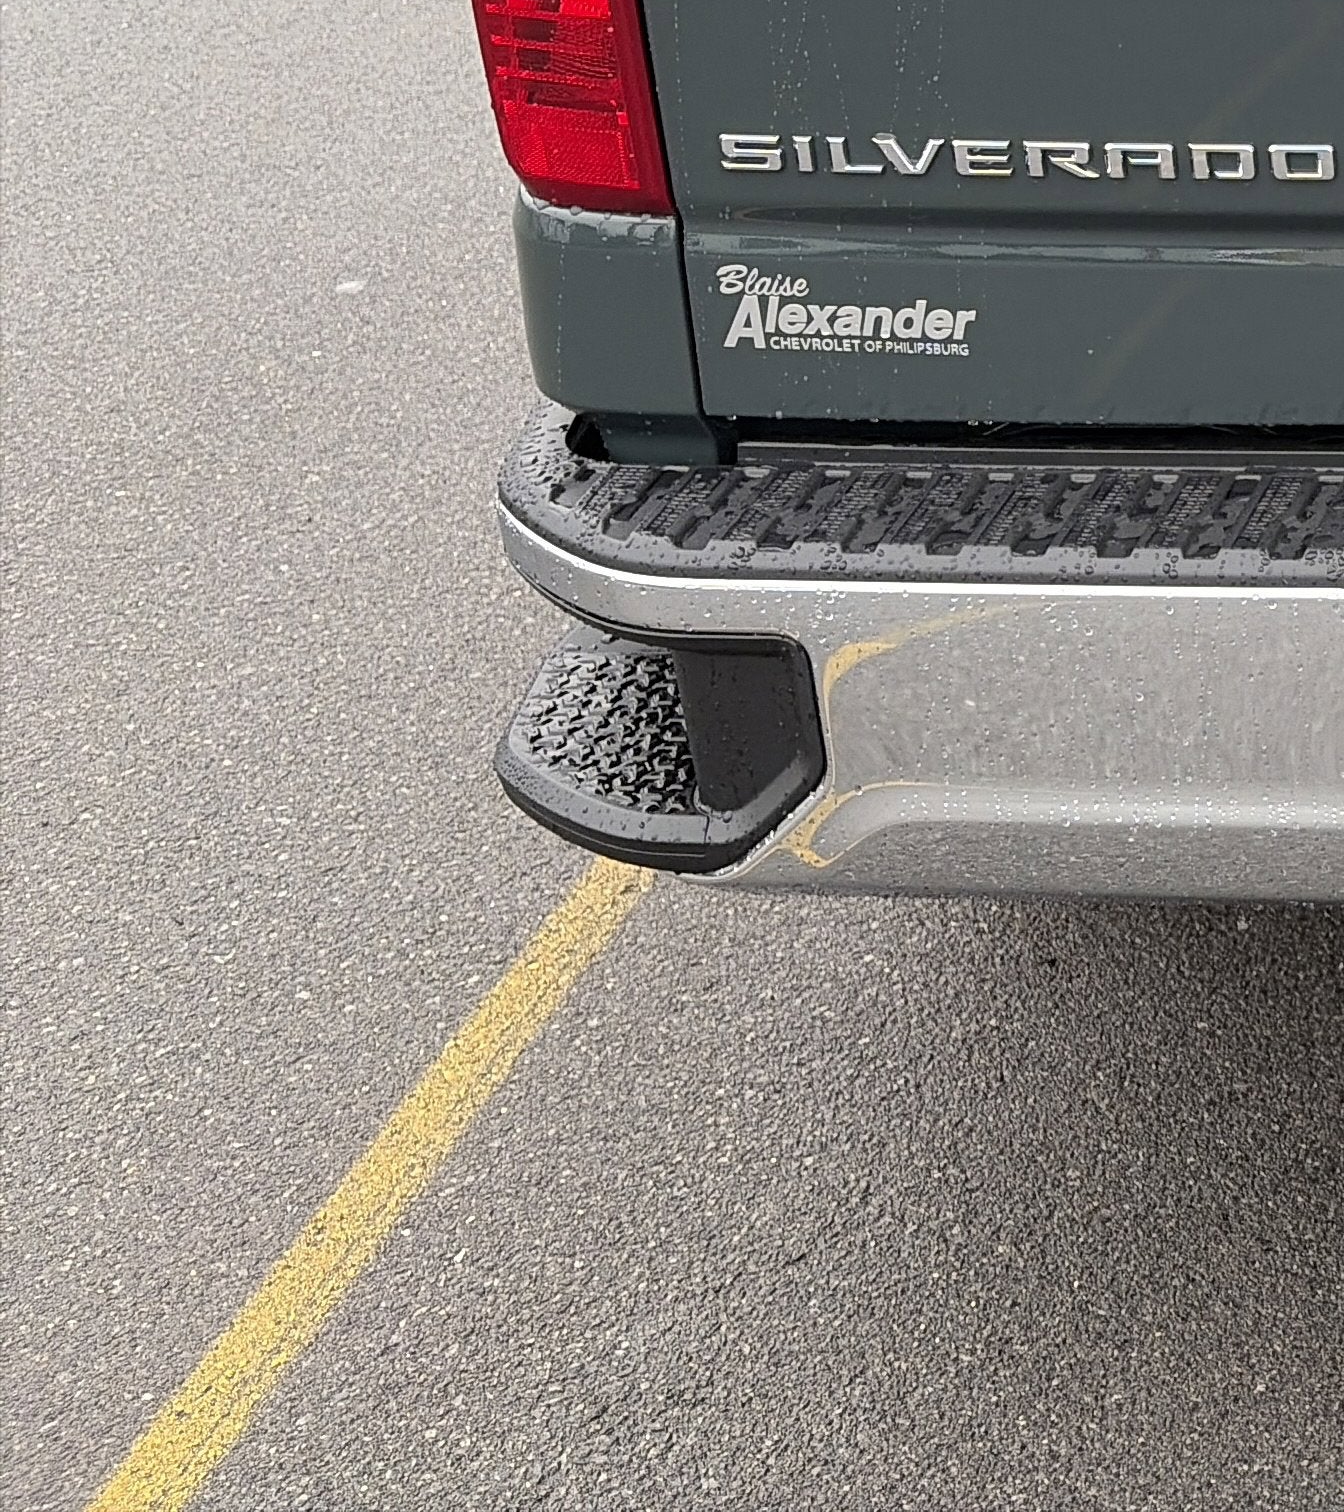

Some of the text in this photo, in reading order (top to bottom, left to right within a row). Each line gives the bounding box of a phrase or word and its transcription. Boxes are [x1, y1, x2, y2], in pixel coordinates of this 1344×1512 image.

[718, 131, 1336, 180] SILVERADO
[716, 264, 810, 297] Blaise
[723, 294, 977, 349] Alexander
[769, 336, 970, 357] CHEVROLET OF PHILIPSBURG
